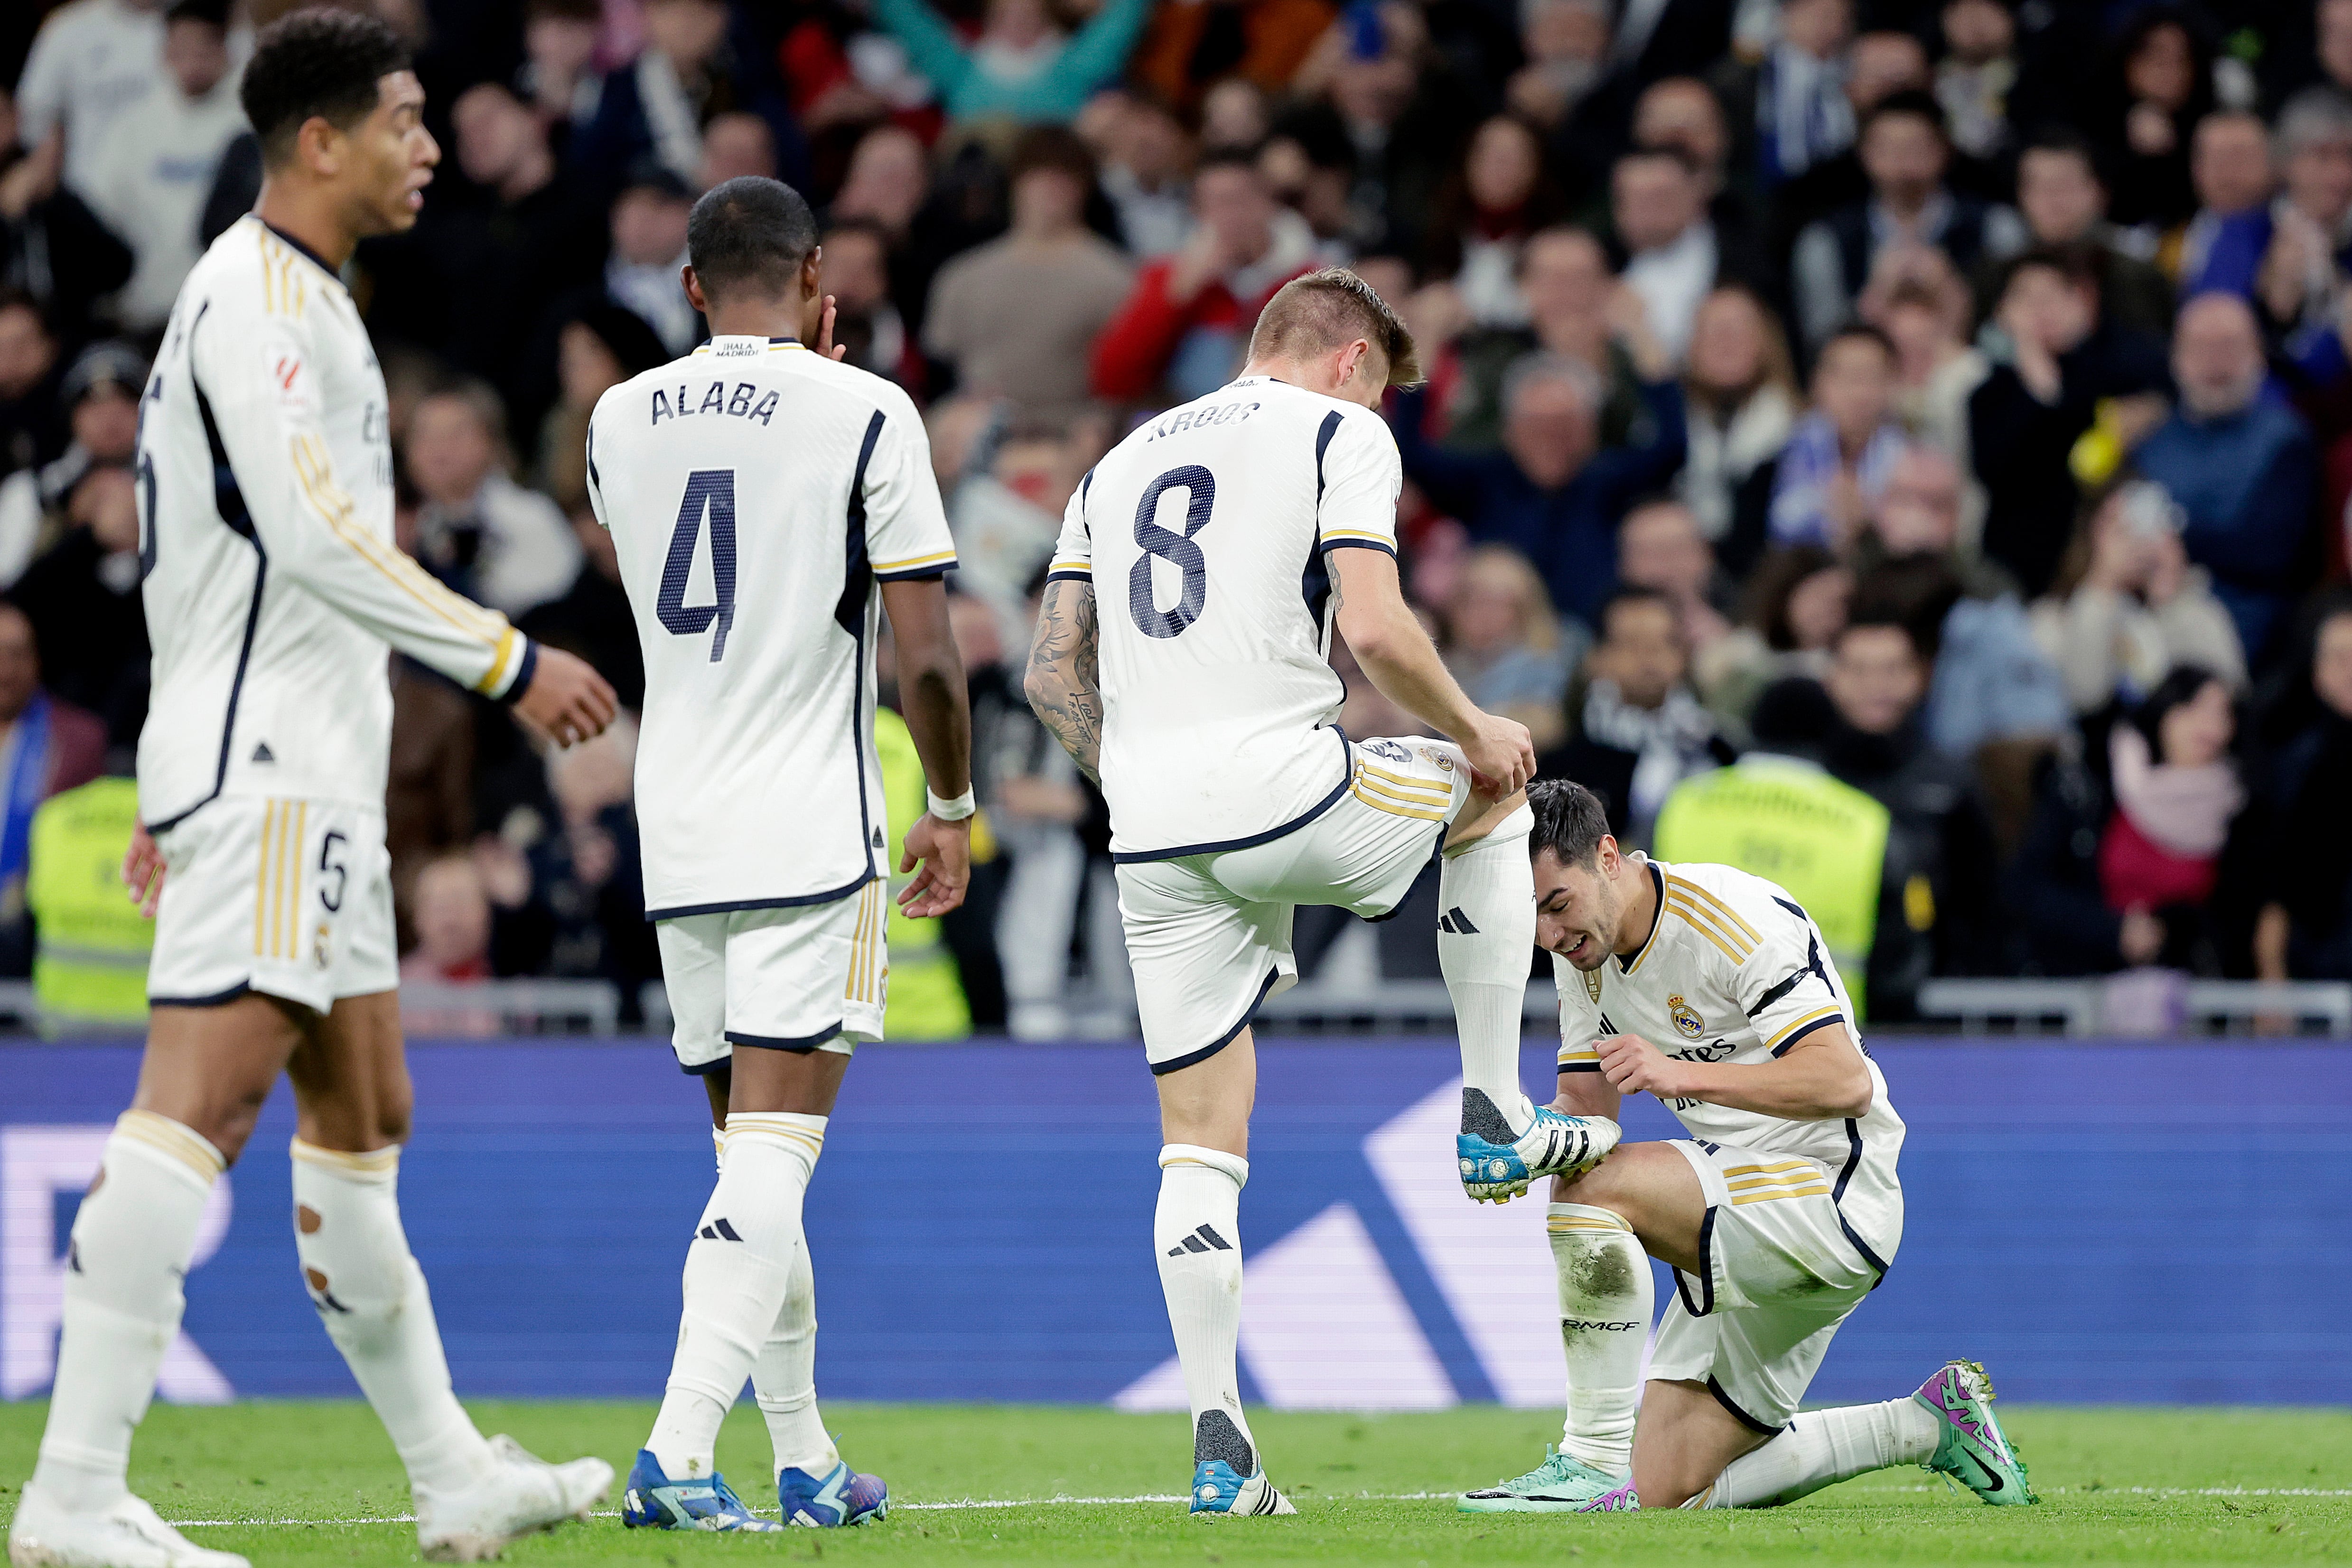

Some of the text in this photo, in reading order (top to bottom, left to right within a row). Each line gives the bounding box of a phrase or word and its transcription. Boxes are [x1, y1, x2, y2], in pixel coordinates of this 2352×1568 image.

[652, 381, 780, 427] ALABA
[1147, 402, 1260, 443] KROOS
[656, 469, 737, 663] 4
[1129, 464, 1215, 639] 8
[320, 832, 346, 912] 5
[1562, 1319, 1640, 1331] RMCF
